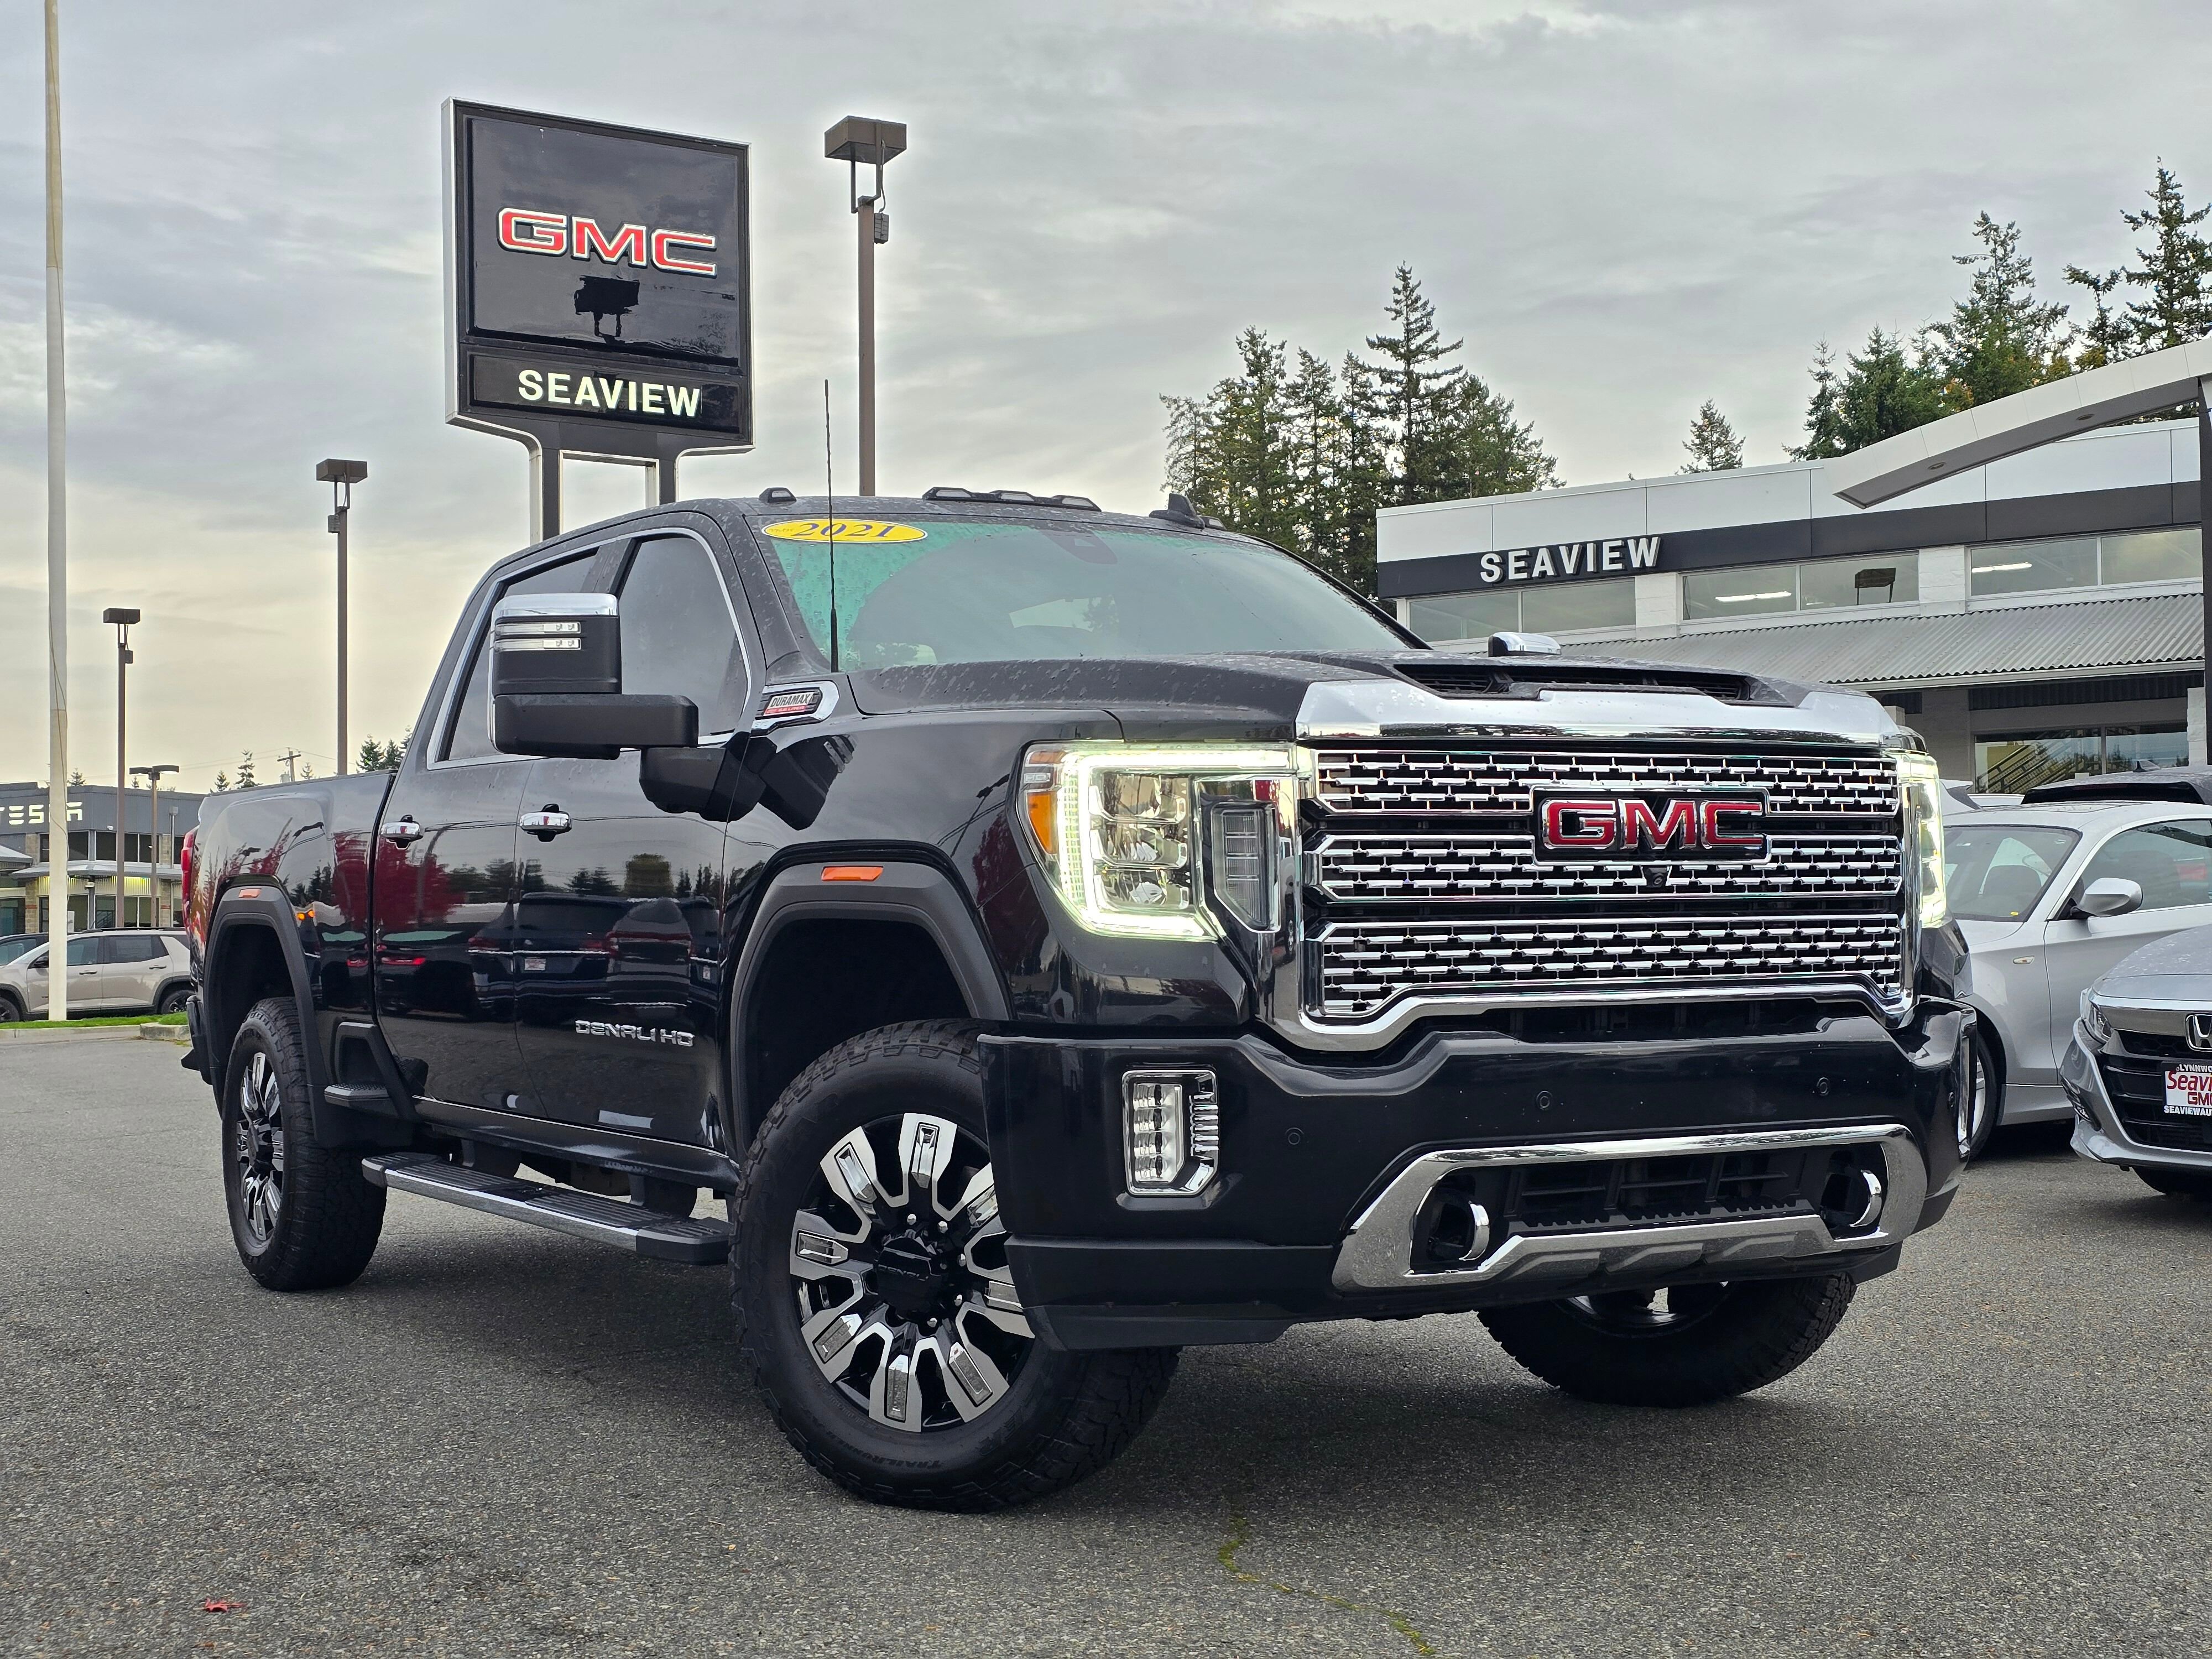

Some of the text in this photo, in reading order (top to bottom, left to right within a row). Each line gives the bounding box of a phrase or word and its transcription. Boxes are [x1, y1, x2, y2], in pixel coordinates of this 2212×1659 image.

[498, 207, 717, 276] GMC
[518, 369, 700, 417] SEAVIEW
[790, 522, 896, 538] 2021
[1480, 536, 1661, 583] SEAVIEW
[770, 693, 811, 707] DURAMAX
[0, 802, 82, 825] ESA
[1542, 798, 1764, 850] GMC
[575, 1020, 695, 1047] DENALI HD
[2163, 1105, 2212, 1116] SEAVIEWAU
[2187, 1092, 2212, 1106] GM
